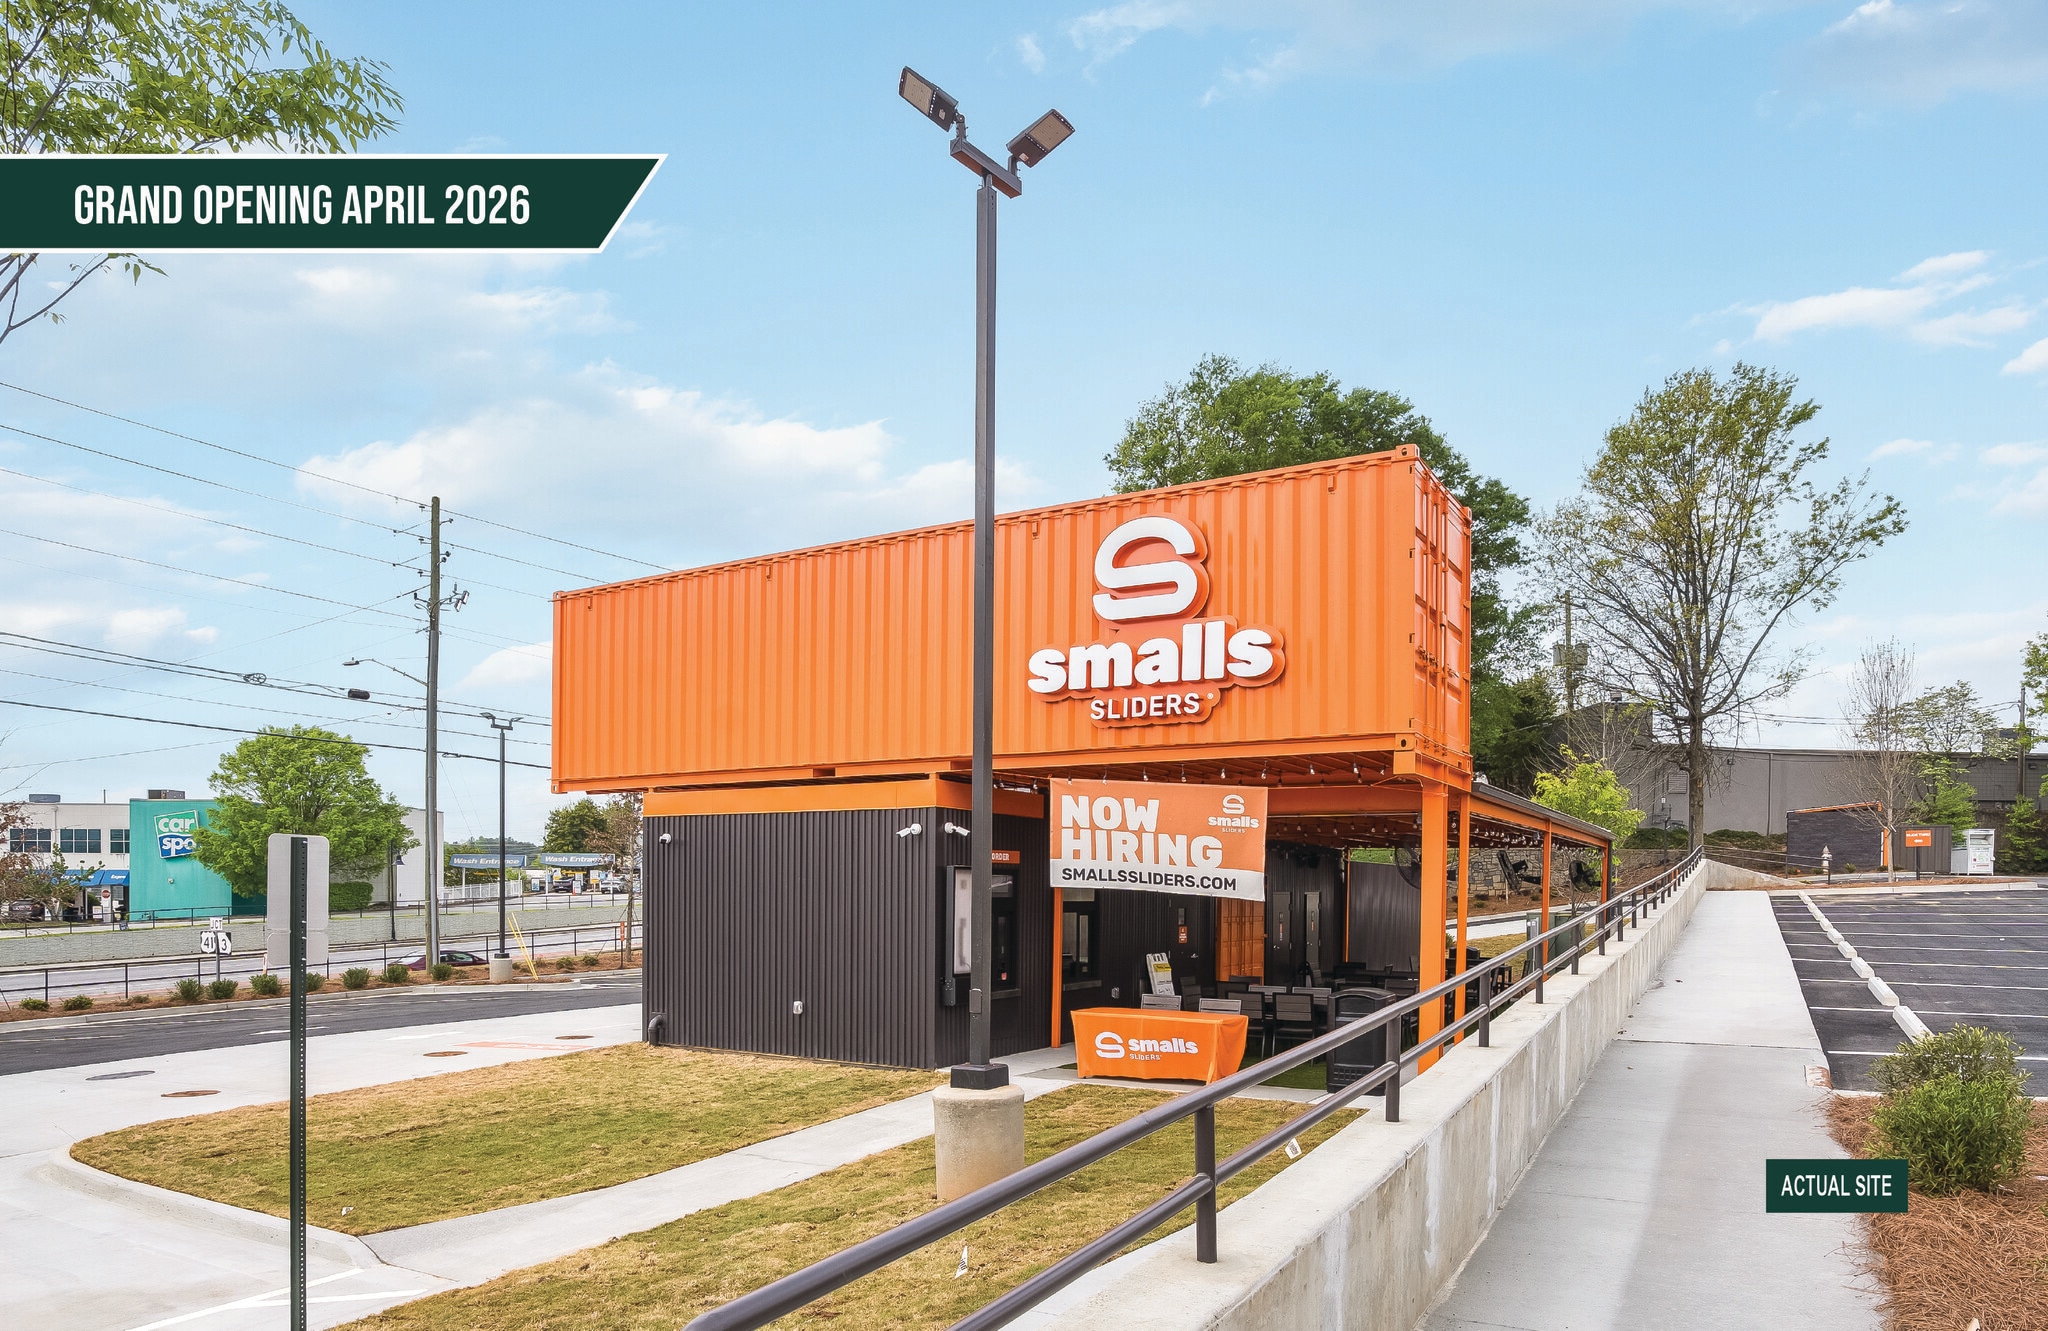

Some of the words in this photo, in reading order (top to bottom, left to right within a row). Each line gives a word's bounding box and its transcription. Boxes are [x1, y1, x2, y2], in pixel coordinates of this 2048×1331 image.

[1027, 620, 1274, 693] smalls
[1061, 794, 1160, 833] NOW
[158, 817, 195, 833] car
[1207, 815, 1260, 829] smalls
[161, 837, 201, 856] spo
[1061, 828, 1223, 869] HIRING
[479, 857, 520, 865] Entrnce
[1061, 867, 1237, 891] SMALLSSLIDERS.COM
[211, 919, 222, 929] JCT
[203, 936, 214, 949] 41
[221, 938, 228, 951] 3
[1128, 1037, 1199, 1054] smalls
